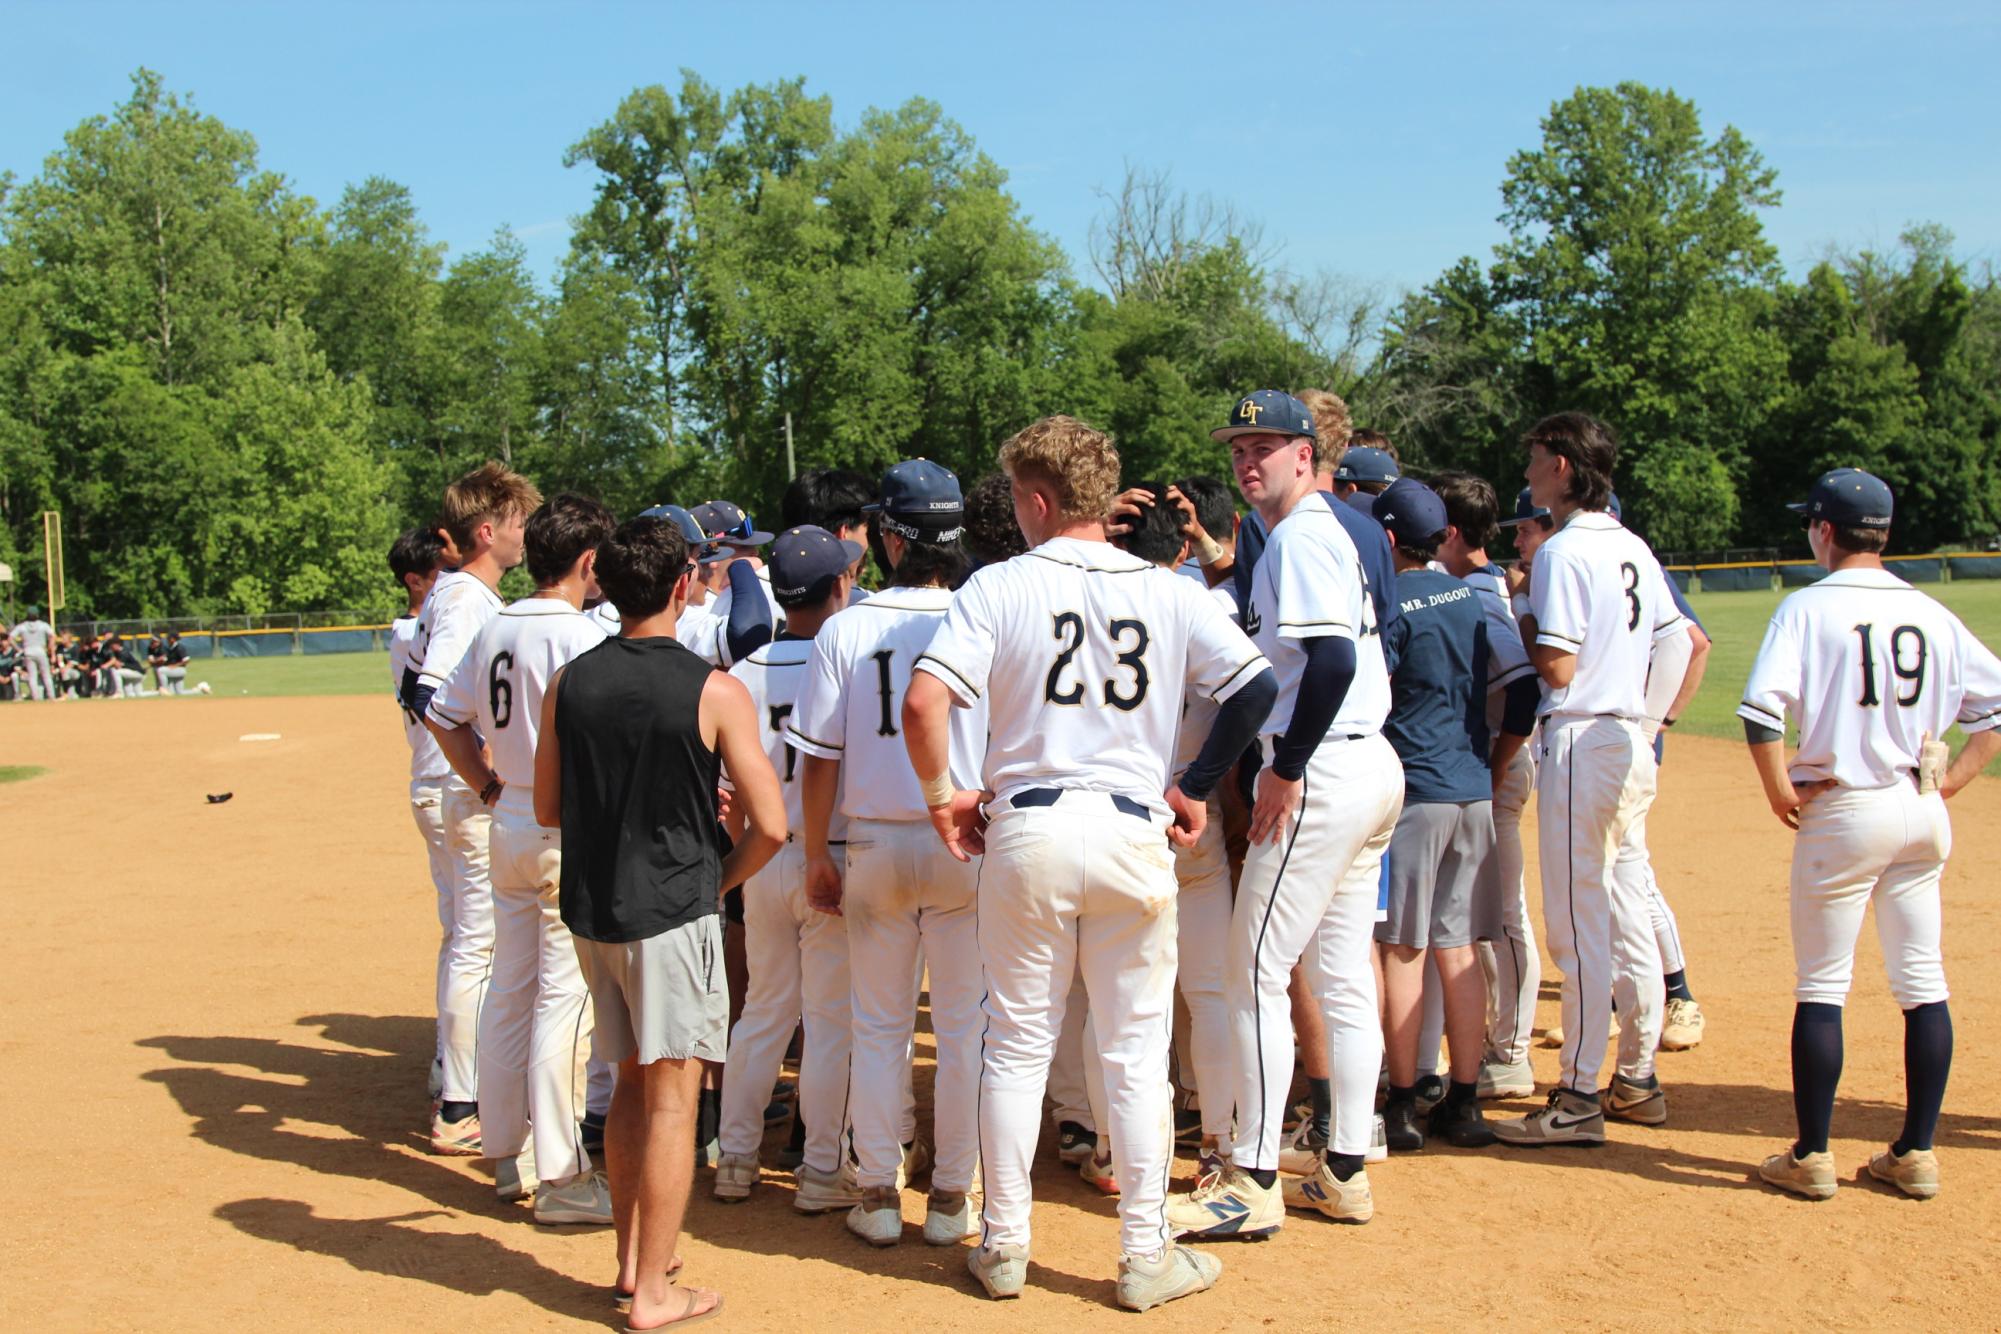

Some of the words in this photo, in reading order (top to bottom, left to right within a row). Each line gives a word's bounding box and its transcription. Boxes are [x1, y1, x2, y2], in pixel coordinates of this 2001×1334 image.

[929, 501, 960, 510] KNIGHTS
[1400, 598, 1427, 614] MR.
[1428, 586, 1471, 607] DUGOUT
[1620, 561, 1641, 633] 3
[488, 650, 514, 731] 6
[1044, 609, 1151, 712] 23
[1851, 622, 1928, 708] 19
